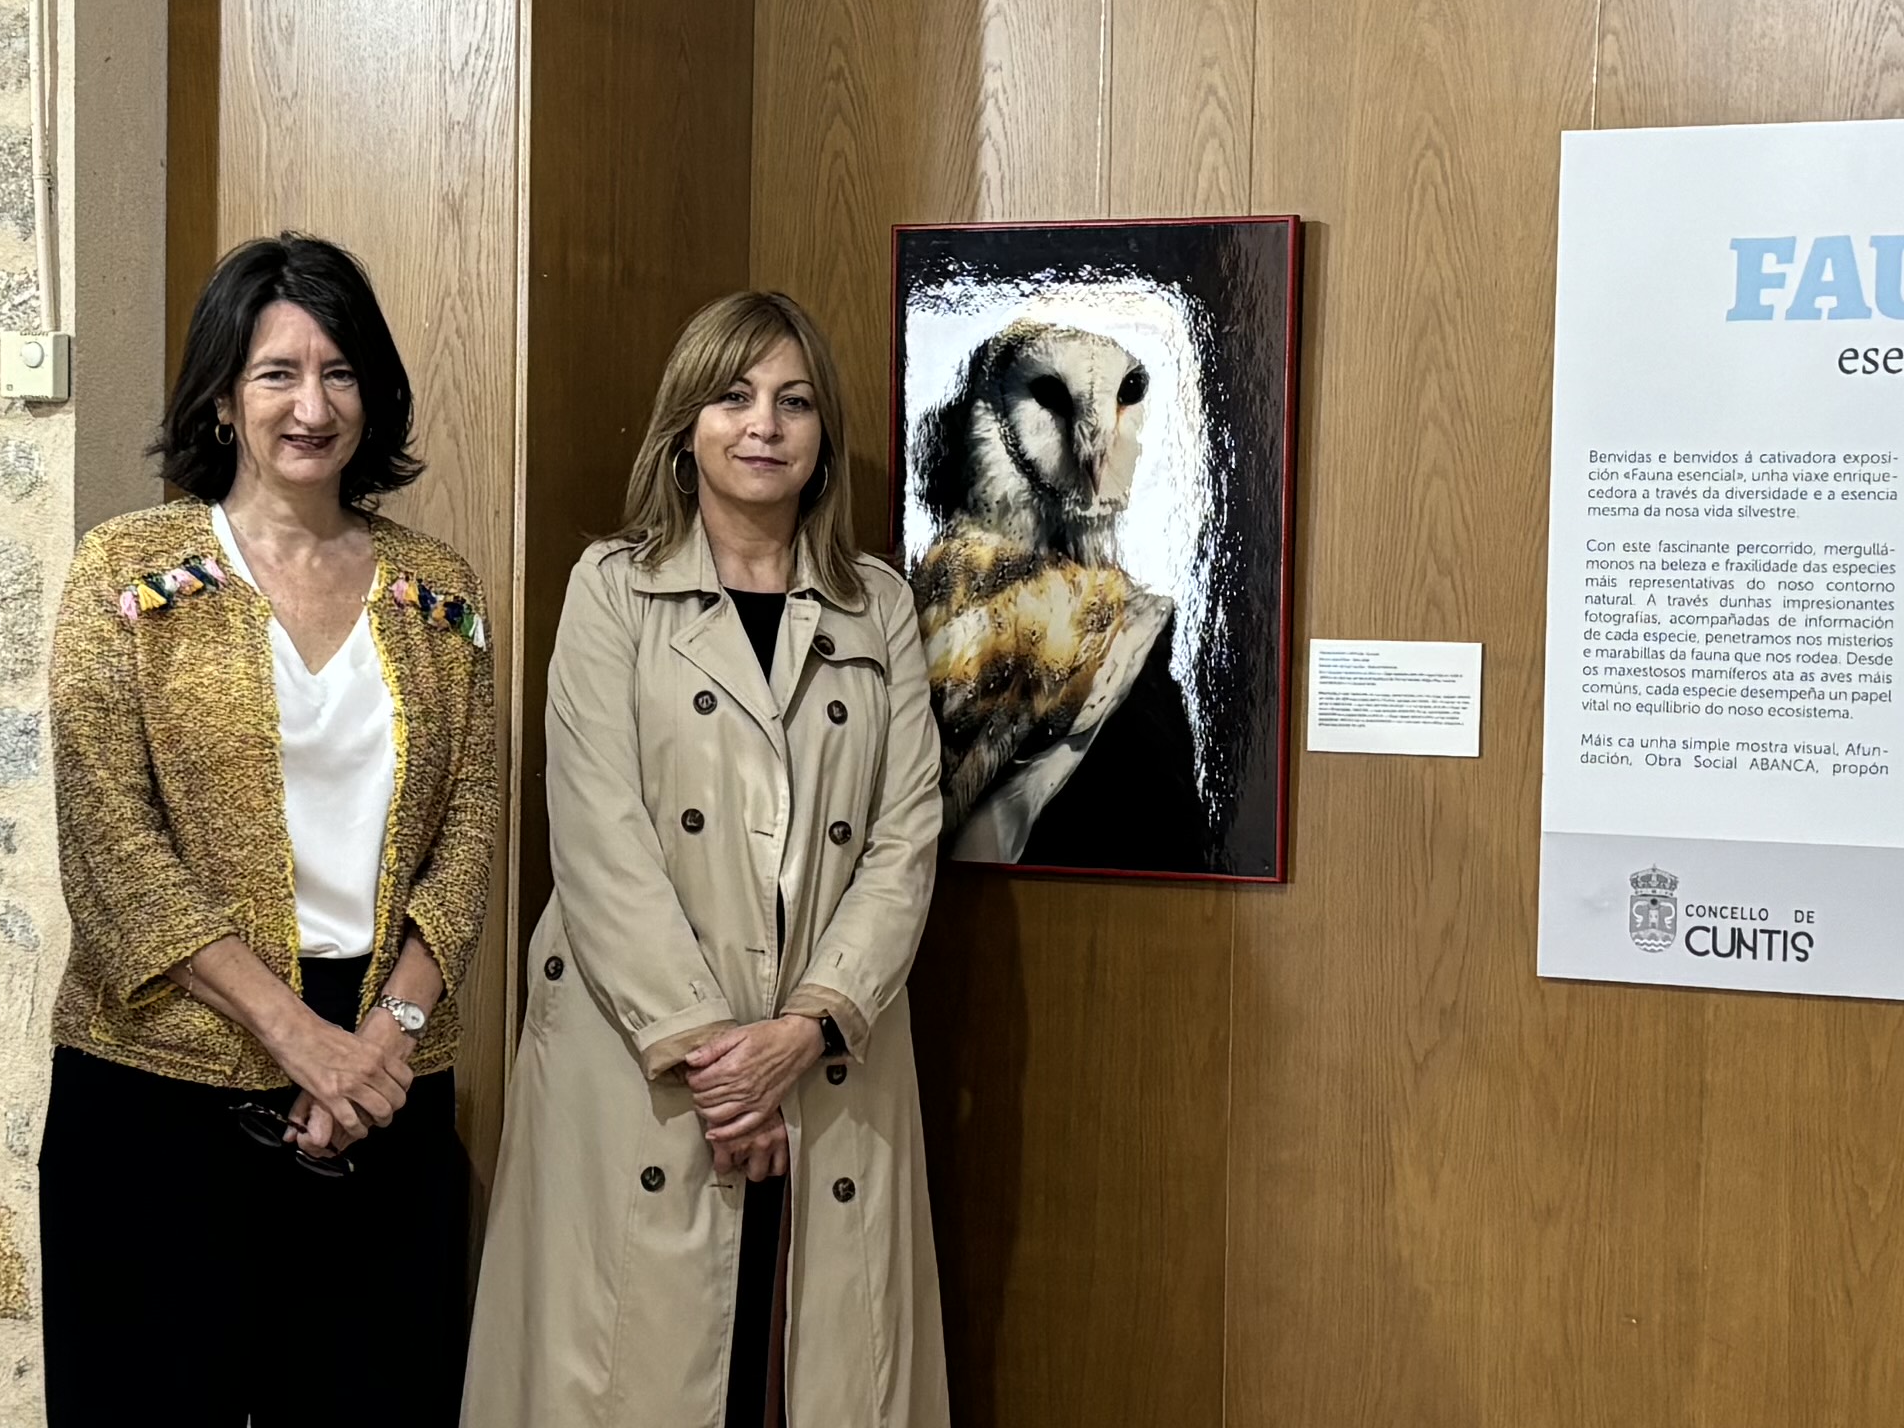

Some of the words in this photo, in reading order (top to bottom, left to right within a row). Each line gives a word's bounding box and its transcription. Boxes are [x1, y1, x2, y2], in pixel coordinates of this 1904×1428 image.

[1589, 450, 1652, 463] Benvidas
[1657, 453, 1667, 463] e
[1673, 450, 1739, 464] benvidos
[1759, 450, 1836, 464] cativadora
[1842, 451, 1898, 467] exposi-
[1588, 468, 1619, 481] ción
[1623, 468, 1673, 481] «Fauna
[1751, 468, 1789, 482] unha
[1792, 469, 1830, 482] viaxe
[1833, 468, 1898, 485] enrique-
[1588, 485, 1637, 499] cedora
[1641, 489, 1650, 499] a
[1655, 486, 1698, 499] través
[1701, 486, 1720, 499] da
[1725, 486, 1809, 500] diversidade
[1812, 490, 1823, 500] e
[1826, 489, 1836, 500] a
[1840, 487, 1898, 500] esencia
[1587, 506, 1640, 516] mesma
[1642, 504, 1661, 517] da
[1665, 506, 1700, 517] nosa
[1703, 504, 1733, 517] vida
[1737, 504, 1799, 518] silvestre.
[1586, 539, 1616, 552] Con
[1622, 541, 1652, 552] este
[1658, 539, 1730, 553] fascinante
[1737, 540, 1816, 557] percorrido,
[1586, 559, 1635, 570] monos
[1638, 560, 1657, 570] na
[1661, 557, 1707, 571] beleza
[1710, 561, 1721, 571] e
[1725, 558, 1798, 573] fraxilidade
[1802, 560, 1828, 573] das
[1832, 560, 1897, 577] especies
[1585, 575, 1618, 587] máis
[1629, 575, 1735, 594] representativas
[1745, 577, 1766, 590] do
[1778, 580, 1815, 591] noso
[1826, 580, 1896, 592] contorno
[1584, 592, 1636, 605] natural.
[1645, 593, 1657, 606] A
[1667, 593, 1709, 607] través
[1719, 594, 1772, 608] dunhas
[1783, 596, 1895, 613] impresionantes
[1669, 612, 1770, 631] acompañadas
[1776, 613, 1797, 627] de
[1804, 614, 1894, 629] información
[1582, 627, 1601, 640] de
[1605, 628, 1639, 641] cada
[1643, 629, 1700, 647] especie,
[1705, 632, 1792, 647] penetramos
[1796, 635, 1823, 646] nos
[1827, 633, 1894, 648] misterios
[1581, 648, 1592, 658] e
[1595, 645, 1666, 660] marabillas
[1668, 647, 1687, 660] da
[1691, 647, 1730, 661] fauna
[1734, 651, 1762, 665] que
[1765, 652, 1792, 663] nos
[1795, 650, 1842, 665] rodea.
[1846, 651, 1893, 666] Desde
[1581, 665, 1599, 676] os
[1604, 665, 1686, 678] maxestosos
[1691, 666, 1768, 681] mamíferos
[1772, 669, 1795, 681] ata
[1798, 671, 1816, 683] as
[1820, 671, 1853, 683] aves
[1858, 670, 1893, 684] máis
[1645, 682, 1680, 696] cada
[1682, 683, 1737, 700] especie
[1740, 685, 1825, 703] desempeña
[1827, 690, 1848, 701] un
[1851, 689, 1892, 705] papel
[1581, 698, 1610, 711] vital
[1612, 701, 1632, 712] no
[1635, 699, 1701, 717] equilibrio
[1703, 702, 1724, 715] do
[1728, 705, 1764, 716] noso
[1767, 704, 1854, 719] ecosistema.
[1581, 733, 1614, 747] Máis
[1617, 737, 1635, 748] ca
[1640, 735, 1677, 750] unha
[1681, 736, 1731, 755] simple
[1736, 740, 1788, 753] mostra
[1793, 741, 1840, 756] visual,
[1845, 743, 1889, 756] Afun-
[1644, 753, 1682, 767] Obra
[1693, 755, 1737, 769] Social
[1749, 757, 1819, 773] ABANCA,
[1832, 761, 1889, 777] propón
[1685, 904, 1769, 922] CONCELLO
[1794, 909, 1815, 924] DE
[1684, 925, 1814, 963] CUNTIS
